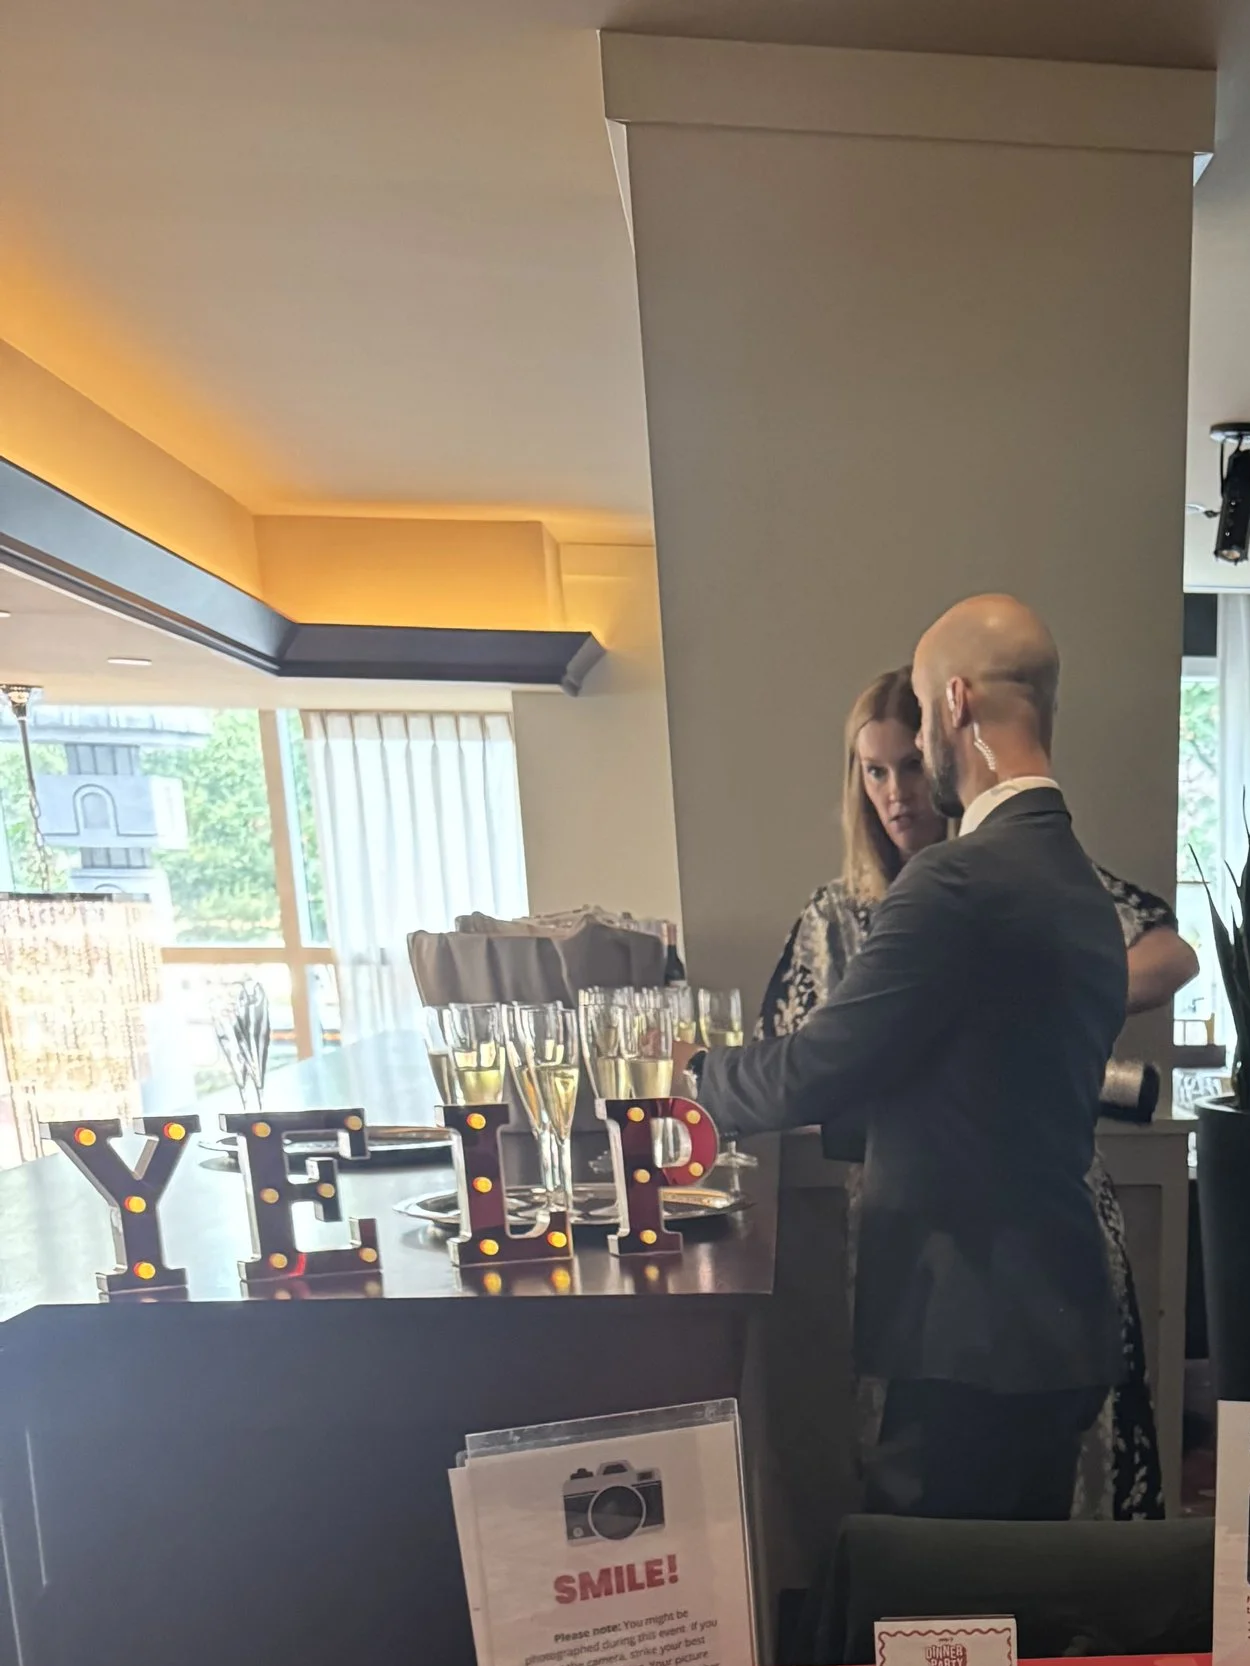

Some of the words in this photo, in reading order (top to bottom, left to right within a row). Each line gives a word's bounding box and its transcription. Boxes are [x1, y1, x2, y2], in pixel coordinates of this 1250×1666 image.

[40, 1097, 717, 1294] YELP
[554, 1554, 679, 1604] SMILE!
[554, 1628, 589, 1642] Please
[593, 1623, 621, 1636] note:
[623, 1619, 643, 1630] You
[645, 1612, 674, 1627] might
[676, 1610, 688, 1619] be
[525, 1641, 600, 1666] photographed
[603, 1634, 636, 1649] during
[638, 1629, 657, 1642] this
[700, 1619, 717, 1633] you
[660, 1642, 682, 1655] your
[685, 1636, 705, 1647] best
[675, 1651, 708, 1666] picture
[925, 1644, 964, 1661] DINNER
